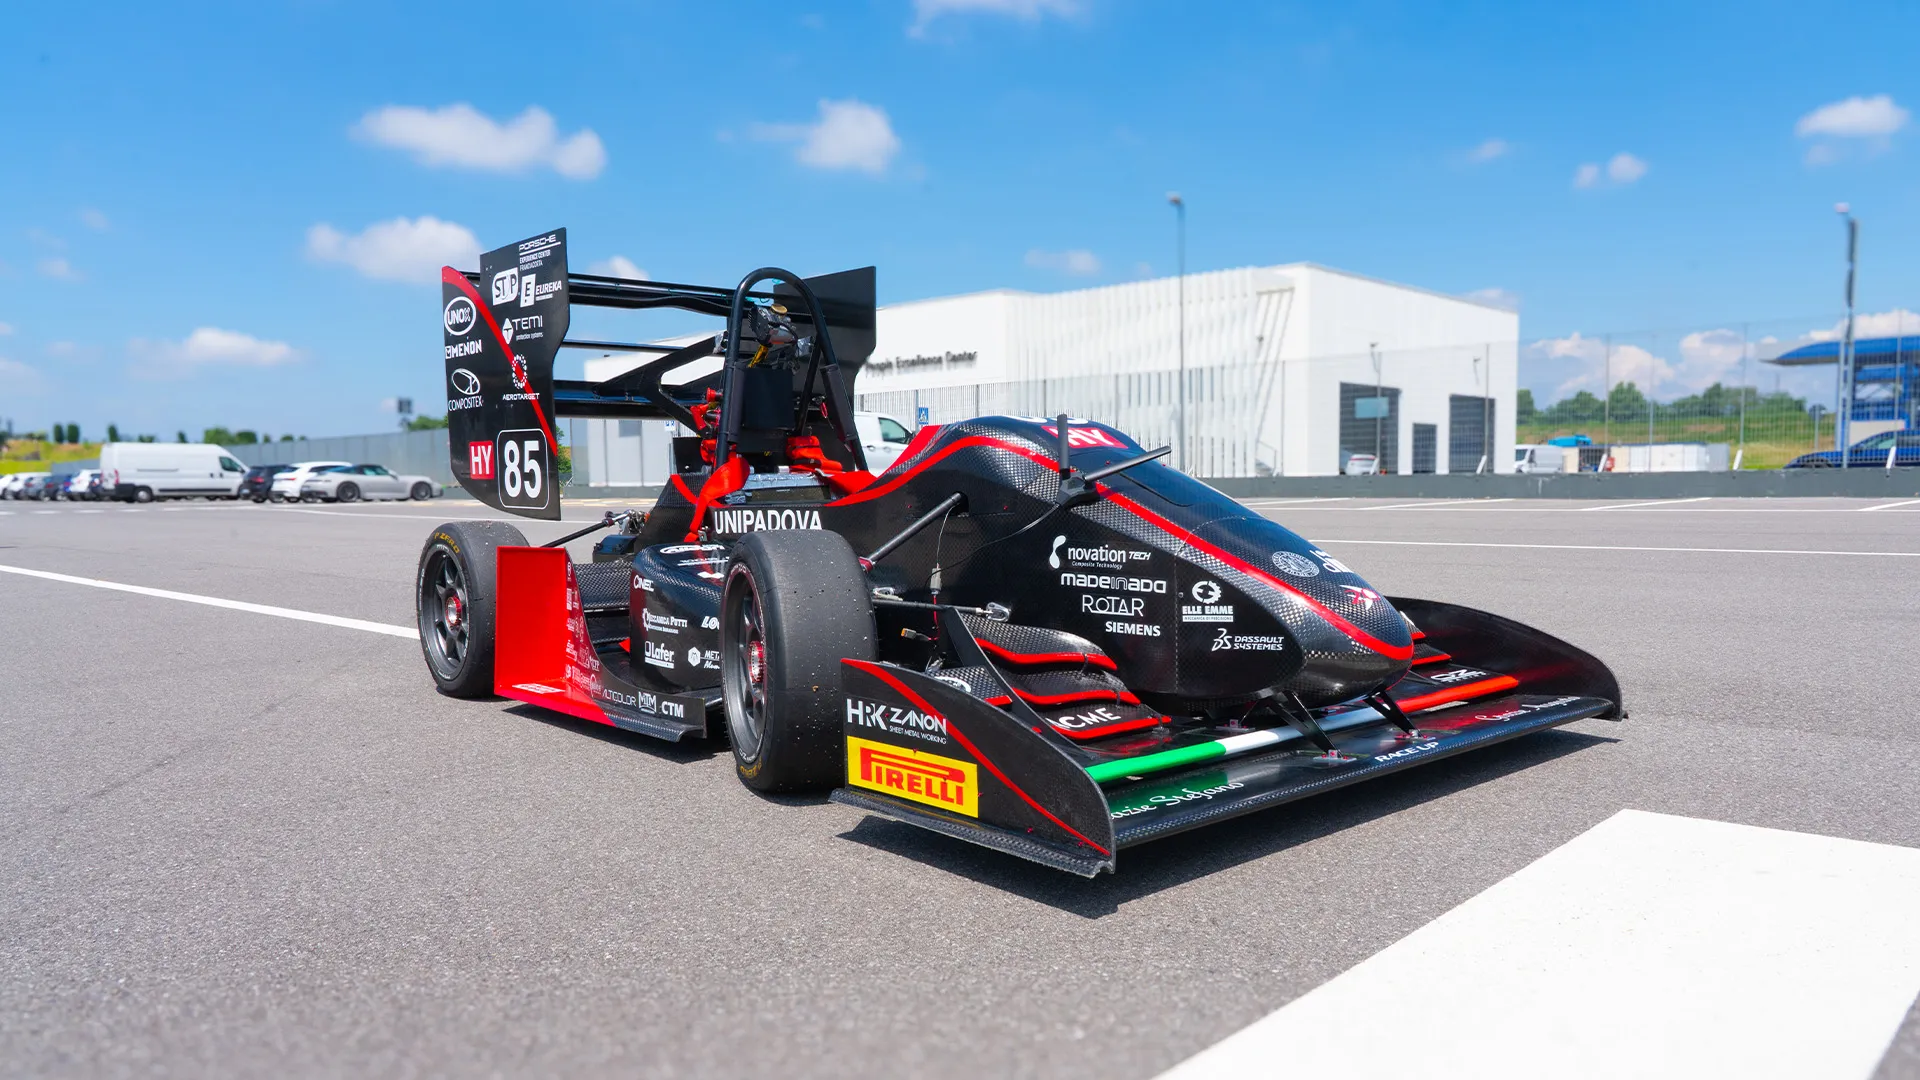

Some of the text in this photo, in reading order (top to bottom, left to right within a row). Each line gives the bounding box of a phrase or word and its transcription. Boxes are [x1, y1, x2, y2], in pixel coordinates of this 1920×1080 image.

[519, 234, 557, 252] PORSCHE
[535, 280, 562, 295] EUREKA
[511, 315, 543, 330] TEMI
[451, 339, 482, 358] MENON
[448, 395, 483, 411] COMPOSITEX
[502, 392, 540, 400] AEROTARGET
[470, 445, 492, 475] HY
[504, 440, 542, 498] 85
[714, 509, 823, 535] UNIPADOVA
[439, 532, 460, 554] ZERO
[1067, 543, 1151, 563] novation TECH
[1071, 560, 1123, 570] Composite Technology
[1182, 605, 1234, 615] ELLE EMME
[1105, 621, 1161, 637] SIEMENS
[1234, 635, 1285, 644] DASSAULT
[661, 700, 684, 718] CTM
[889, 707, 948, 736] ZANON
[889, 725, 947, 745] SHEET METAL WORKING
[1374, 741, 1439, 762] RACE UP
[859, 746, 966, 806] PIRELLI
